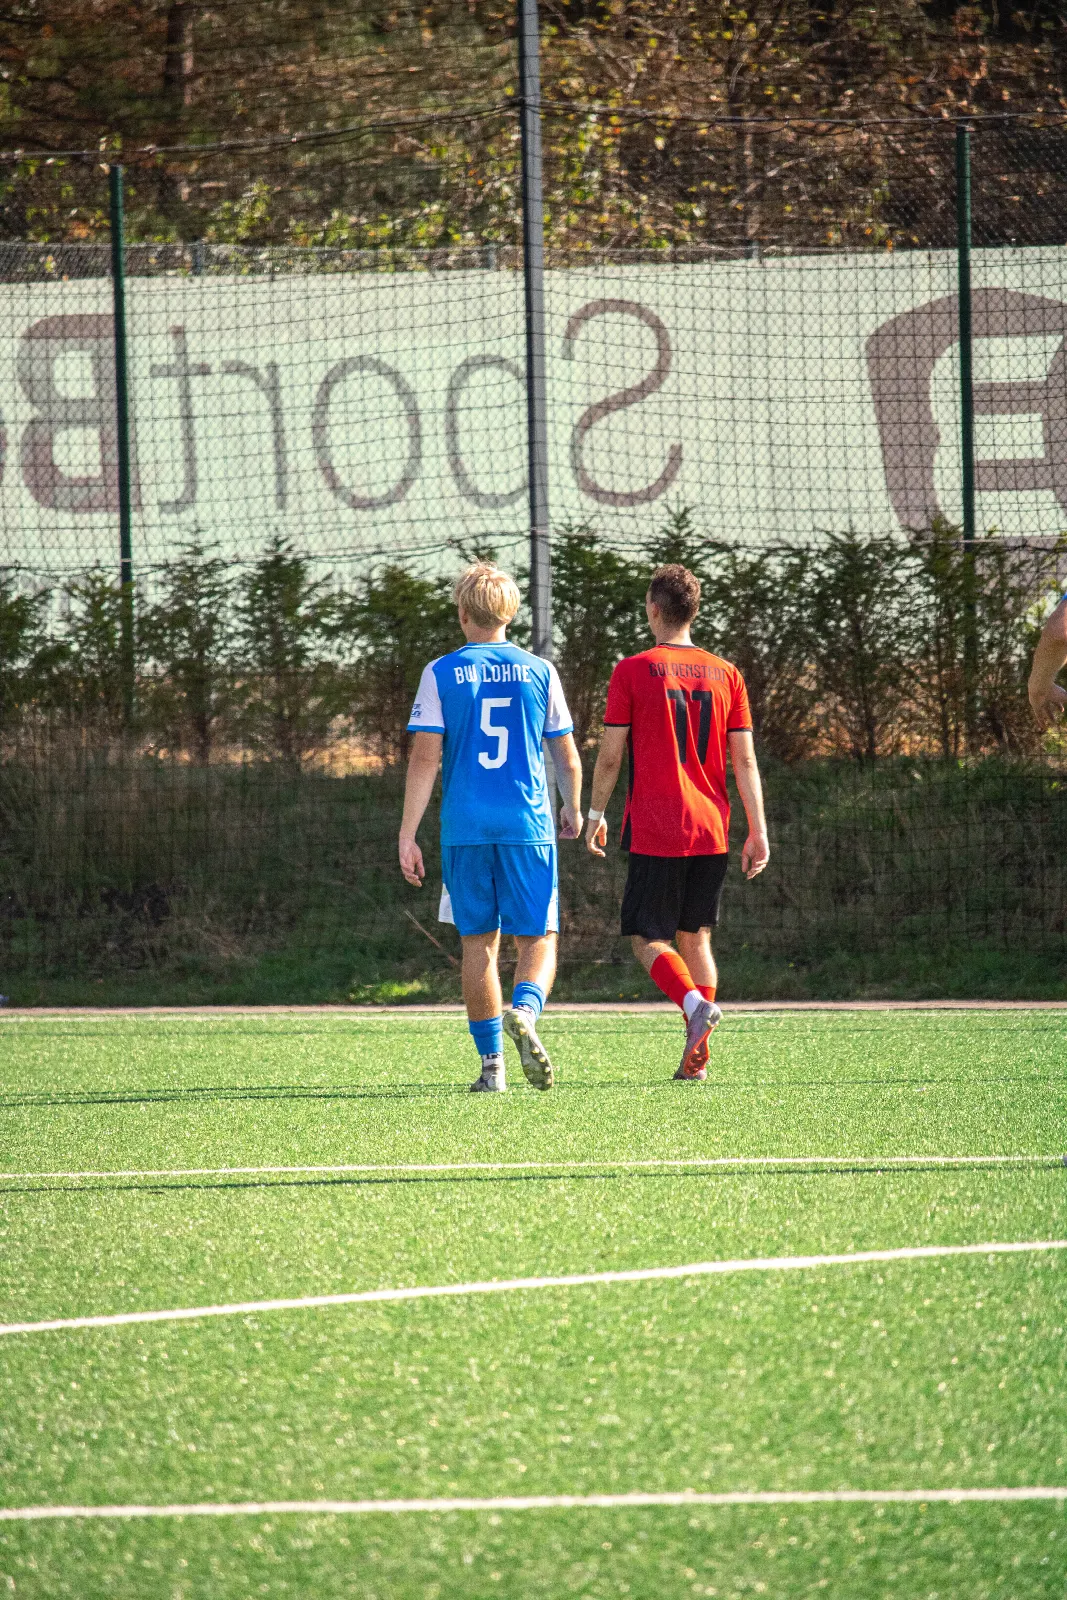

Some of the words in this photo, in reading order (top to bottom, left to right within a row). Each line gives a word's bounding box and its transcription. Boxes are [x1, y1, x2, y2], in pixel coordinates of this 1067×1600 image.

[453, 663, 478, 685] BW
[481, 663, 532, 683] LOHNE
[648, 662, 727, 684] GOLDENSTEDT
[478, 697, 513, 769] 5
